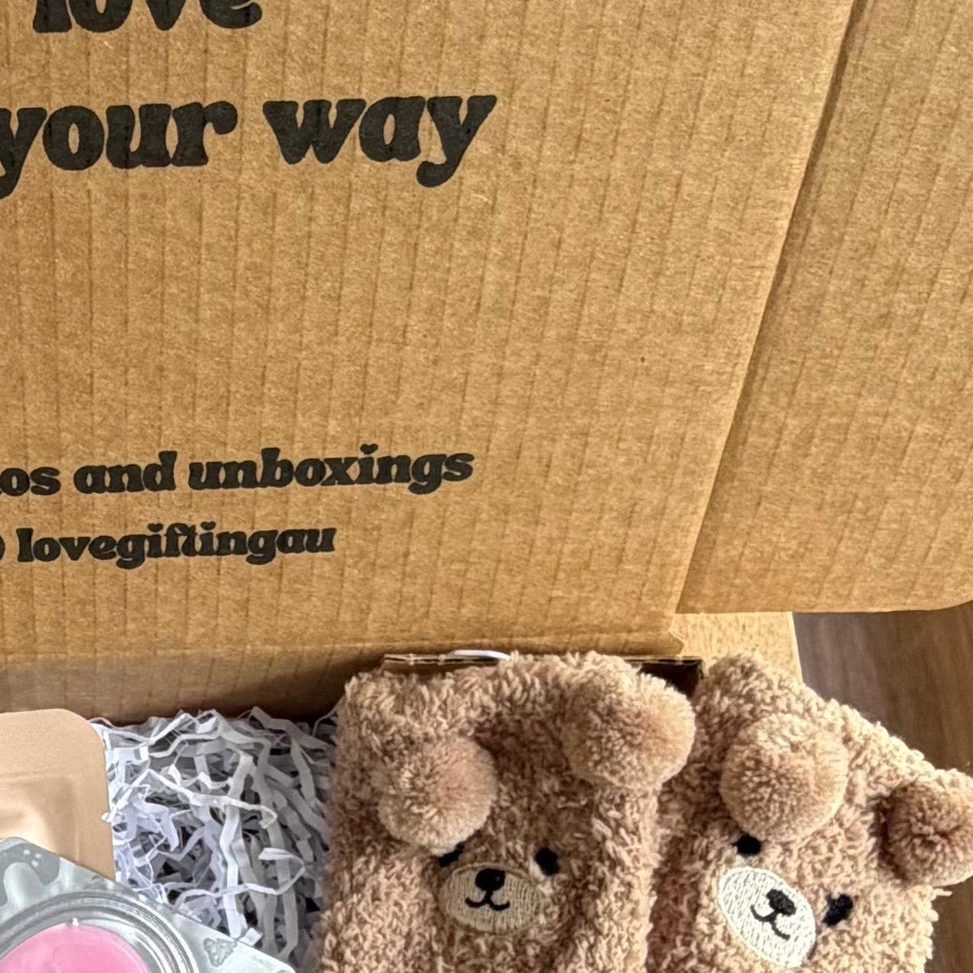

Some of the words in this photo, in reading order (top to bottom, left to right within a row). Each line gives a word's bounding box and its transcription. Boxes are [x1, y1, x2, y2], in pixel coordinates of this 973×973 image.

[263, 95, 497, 188] way
[73, 450, 178, 494] and
[188, 443, 475, 495] unboxings
[16, 521, 337, 569] lovegiftingau
